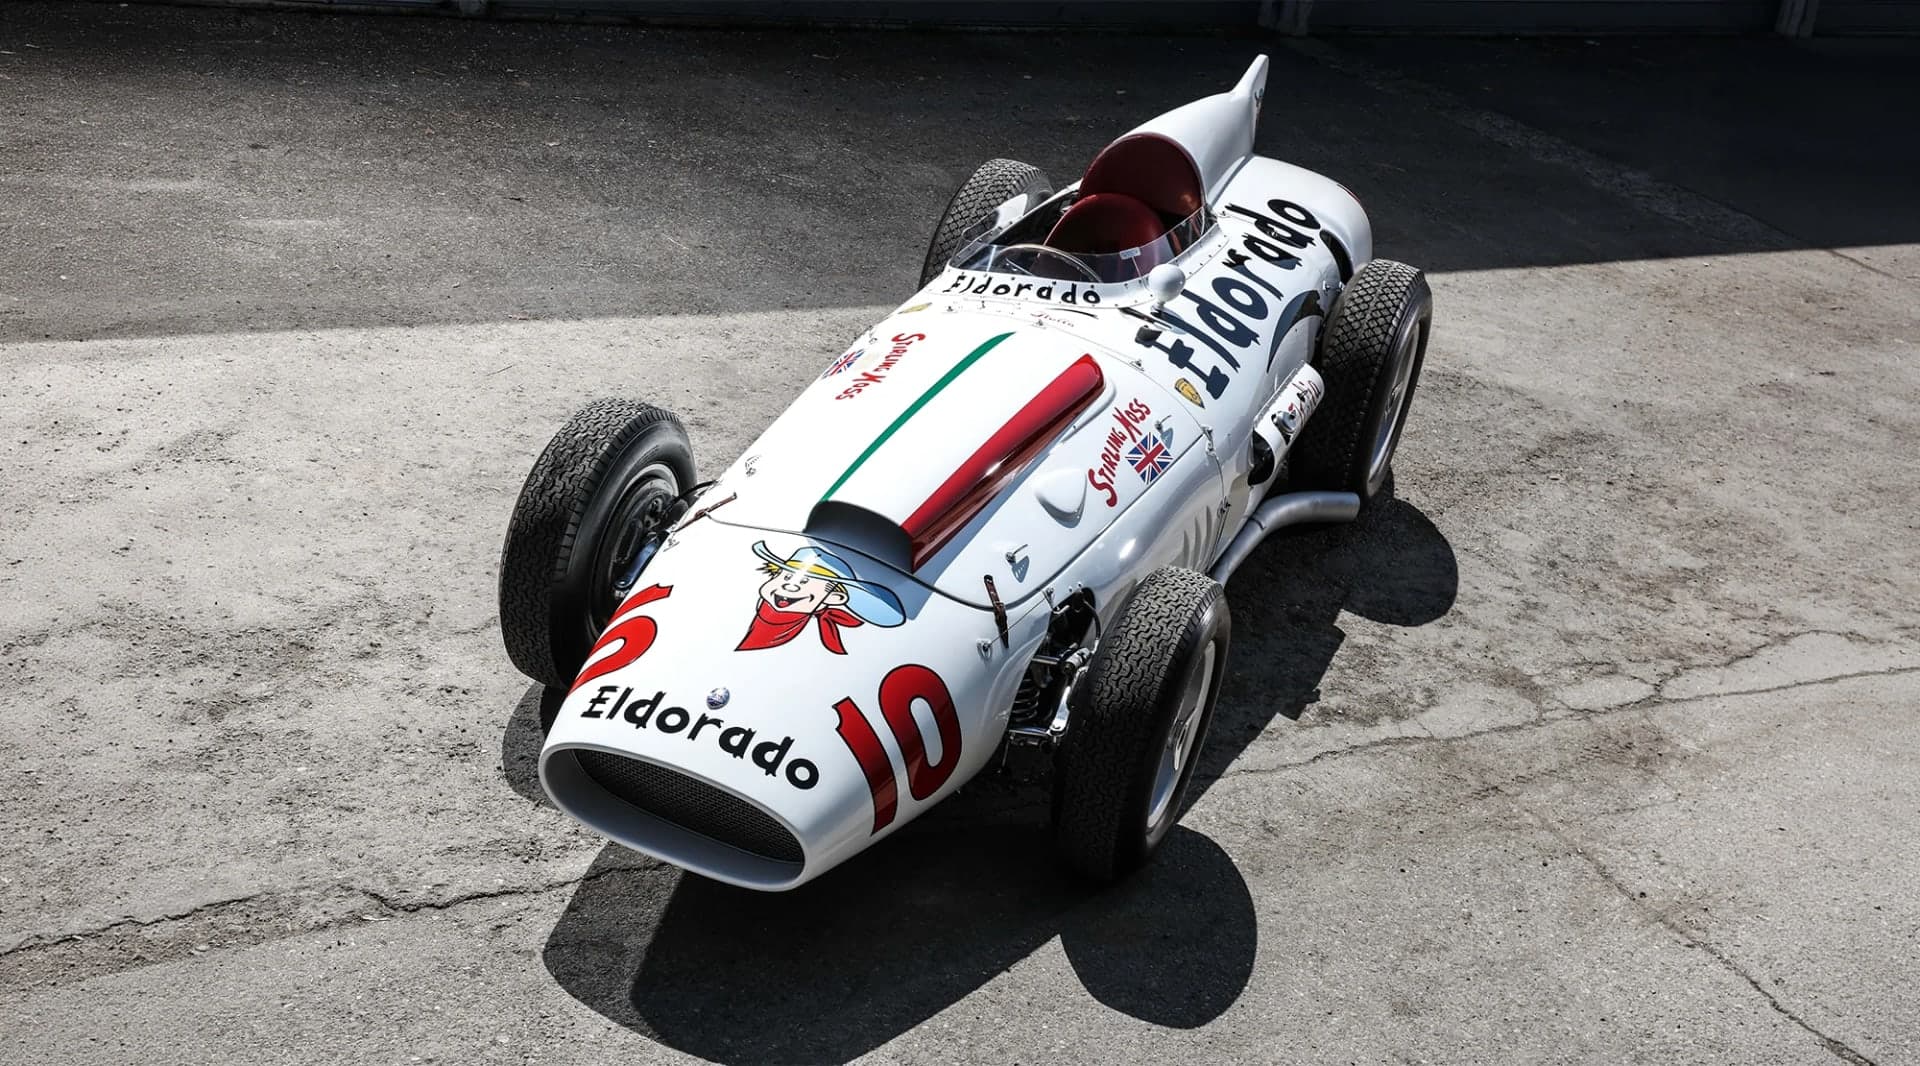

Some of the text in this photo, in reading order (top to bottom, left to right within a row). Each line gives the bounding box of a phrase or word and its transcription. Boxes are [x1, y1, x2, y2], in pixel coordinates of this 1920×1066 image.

[943, 273, 1101, 305] Eldorado
[1135, 199, 1321, 400] Eldorado
[835, 333, 926, 400] STIRLING MOSS
[1088, 398, 1152, 508] STIRLING MOSS
[581, 685, 820, 790] Eldorado
[832, 664, 963, 837] 10
